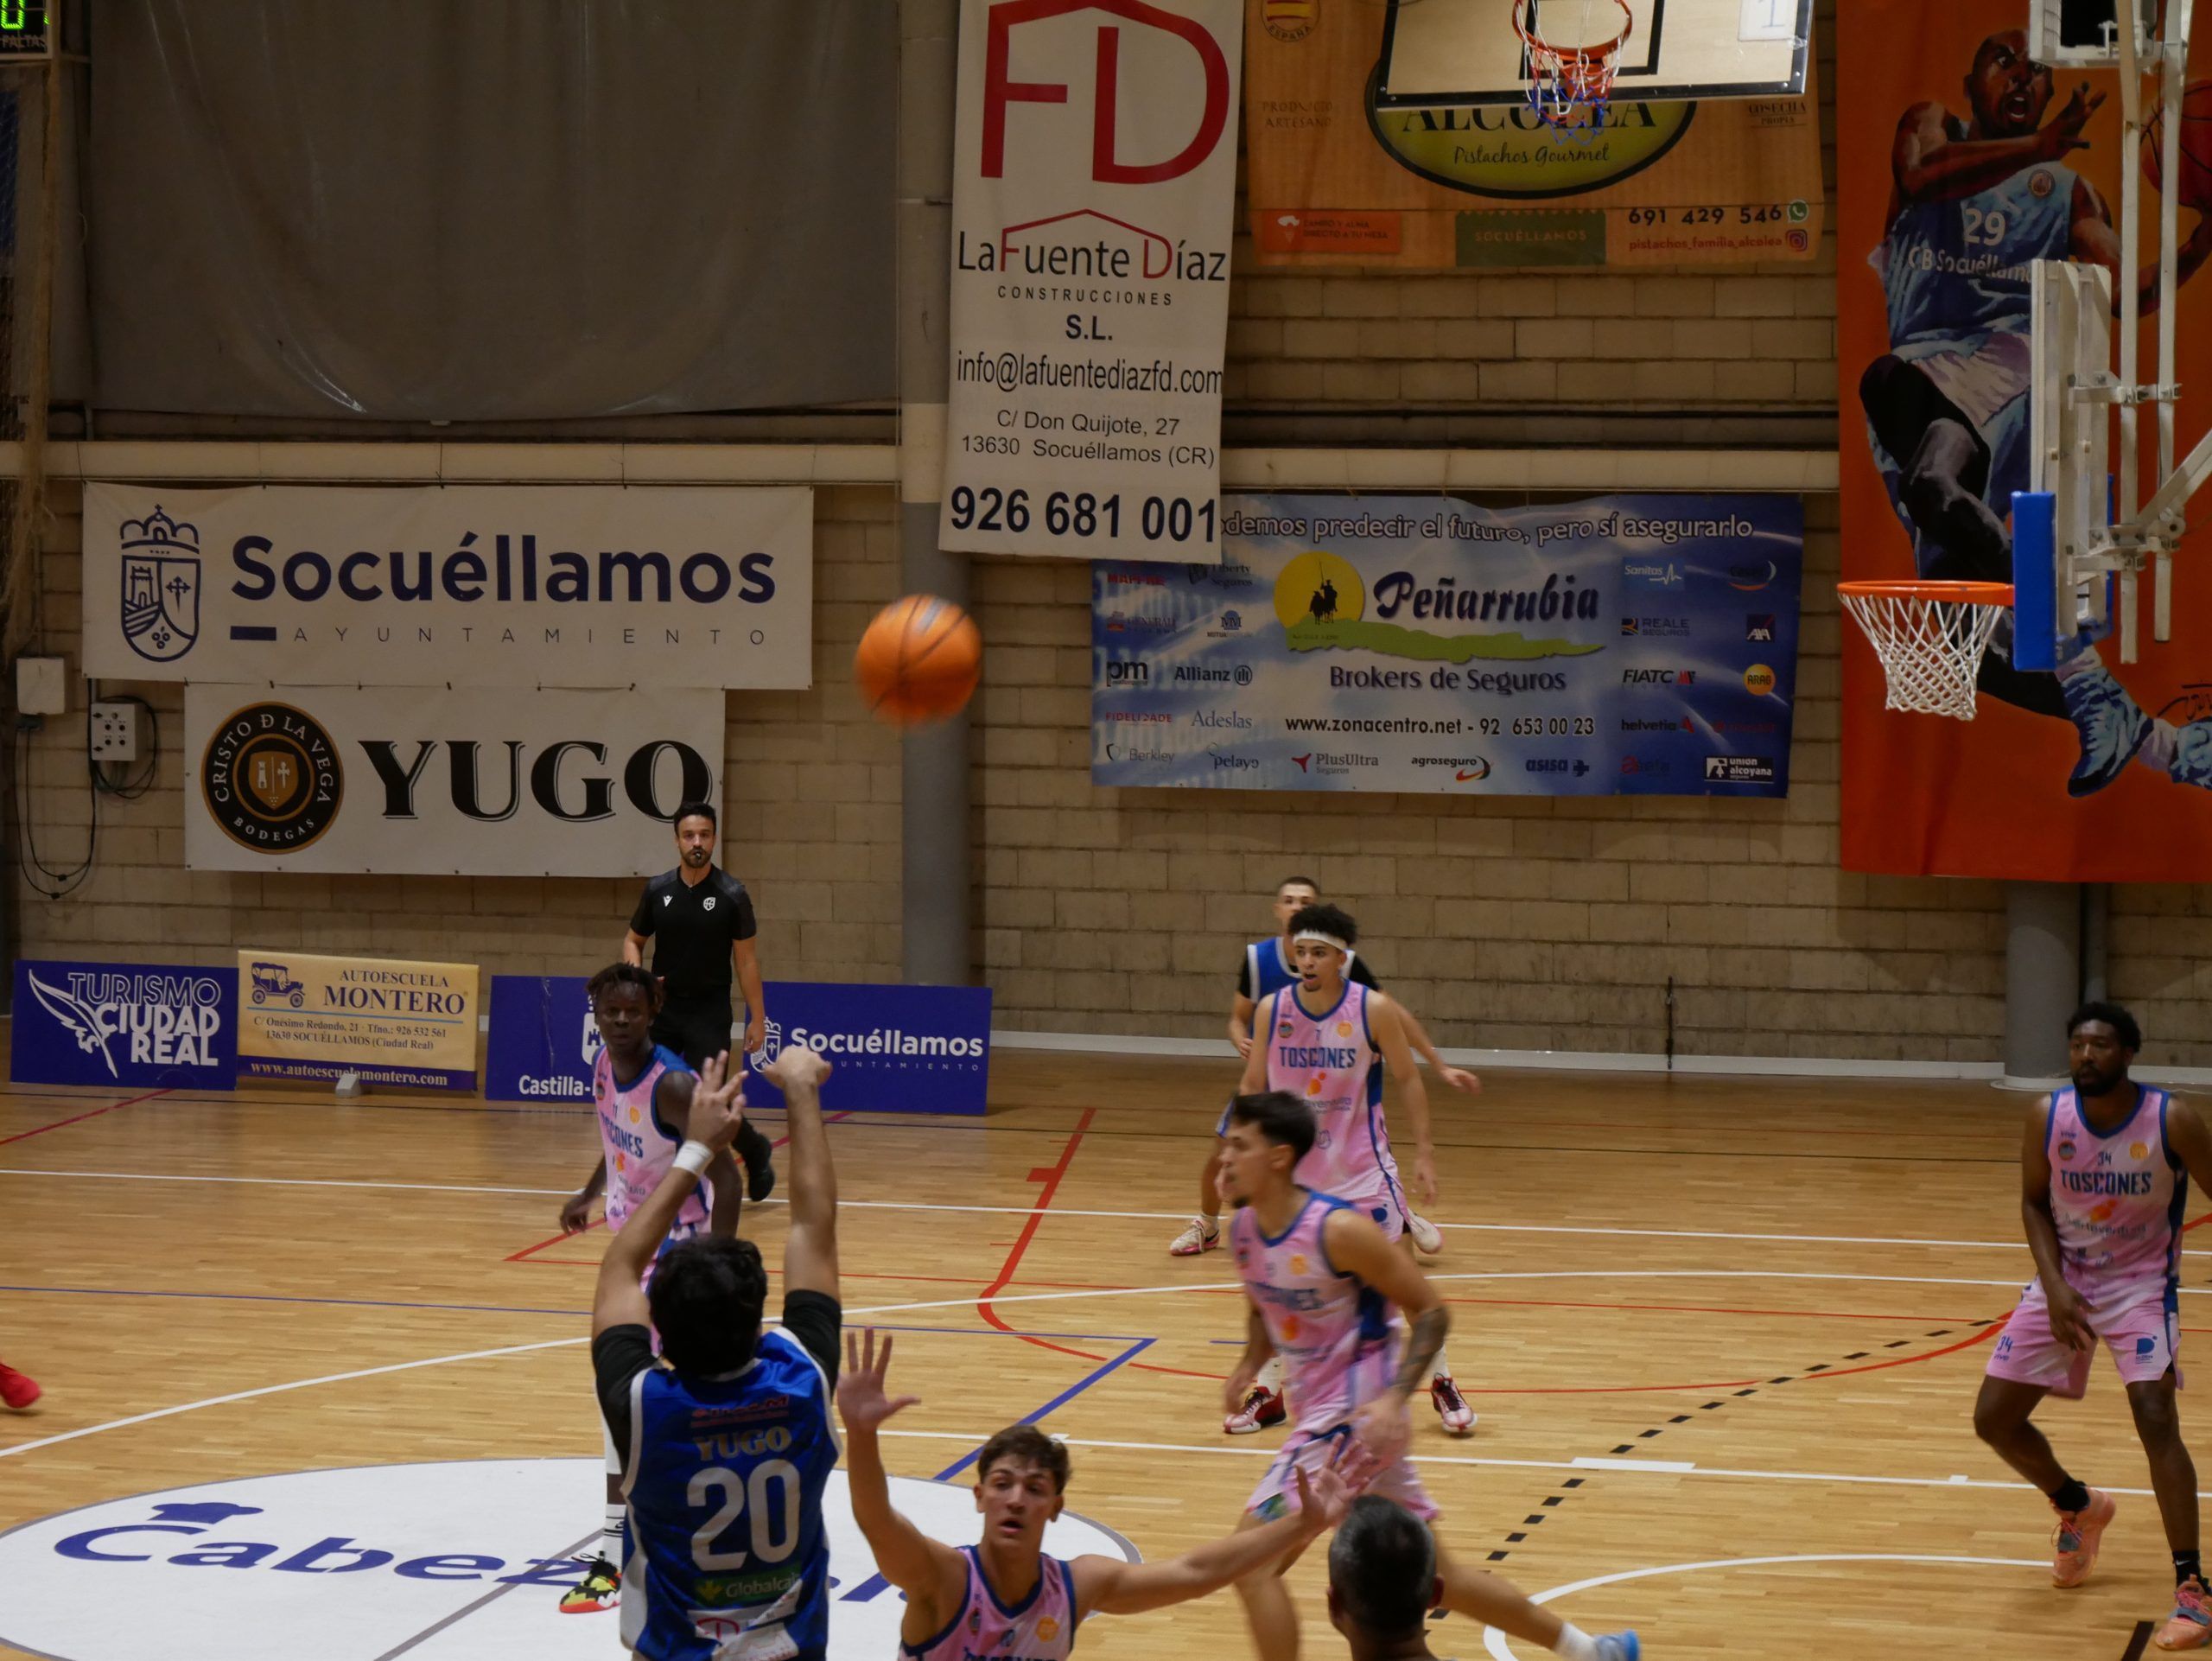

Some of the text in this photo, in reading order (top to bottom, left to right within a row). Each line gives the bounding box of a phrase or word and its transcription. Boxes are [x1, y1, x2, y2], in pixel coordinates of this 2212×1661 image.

[980, 0, 1230, 185] FD
[1453, 142, 1610, 167] Pistachos Gourmet
[1628, 205, 1783, 226] 691 429 546
[1964, 207, 2006, 246] 29
[1142, 234, 1226, 281] Díaz
[1936, 249, 2031, 283] Socuéllam
[997, 285, 1172, 305] CONSTRUCCIONES
[1065, 314, 1113, 341] S.L.
[957, 349, 1224, 394] info@lafuentediazfd.com
[997, 409, 1180, 437] C/ Don Quijote, 27
[962, 435, 1215, 469] 13630 Socuéllamos (CR)
[950, 485, 1216, 543] 926 681 001
[1313, 512, 1416, 544] predecir
[1421, 512, 1443, 538] el
[1449, 515, 1531, 544] futuro,
[1537, 519, 1594, 547] pero
[1598, 511, 1620, 538] sí
[1623, 513, 1753, 544] asegurarlo
[231, 530, 776, 604] Socuéllamos
[1624, 564, 1663, 576] Sanitas
[1372, 570, 1599, 622] Peñarrubia
[293, 627, 766, 646] AYUNTAMIENTO
[1643, 618, 1690, 629] REALE
[1746, 628, 1771, 641] AXA
[1173, 665, 1231, 682] Allianz
[1329, 665, 1567, 697] Brokers de Seguros
[1622, 669, 1675, 684] FIATC
[1191, 710, 1253, 729] Adeslas
[1285, 716, 1462, 735] www.zonacentro.net
[1479, 717, 1500, 735] 92
[1512, 716, 1543, 736] 653
[1548, 716, 1568, 736] 00
[1573, 716, 1595, 736] 23
[1621, 718, 1677, 731] helvetia
[213, 721, 251, 803] CRISTO
[311, 739, 334, 803] VEGA
[1128, 748, 1175, 764] Berkley
[1315, 753, 1379, 767] PlusUltra
[1411, 755, 1478, 768] agroseguro
[1525, 759, 1569, 773] asisa
[357, 739, 714, 823] YUGO
[233, 817, 315, 842] BODEGAS
[67, 972, 221, 1009] TURISMO
[339, 969, 449, 988] AUTOESCUELA
[322, 984, 466, 1015] MONTERO
[95, 1002, 220, 1037] CIUDAD
[349, 1023, 359, 1033] 21
[396, 1025, 412, 1035] 926
[413, 1027, 430, 1036] 532
[431, 1028, 448, 1038] 561
[131, 1031, 219, 1066] REAL
[266, 1029, 291, 1041] 13630
[372, 1035, 409, 1049] (Ciudad
[410, 1039, 435, 1051] Real)
[790, 1027, 983, 1058] Socuéllamos
[826, 1060, 980, 1072] UNTAMIENTO
[1279, 1046, 1357, 1069] TOSCONES
[518, 1074, 594, 1097] Castilla-
[2060, 1168, 2152, 1196] TOSCONES
[692, 1425, 792, 1462] YUGO
[687, 1458, 801, 1572] 20
